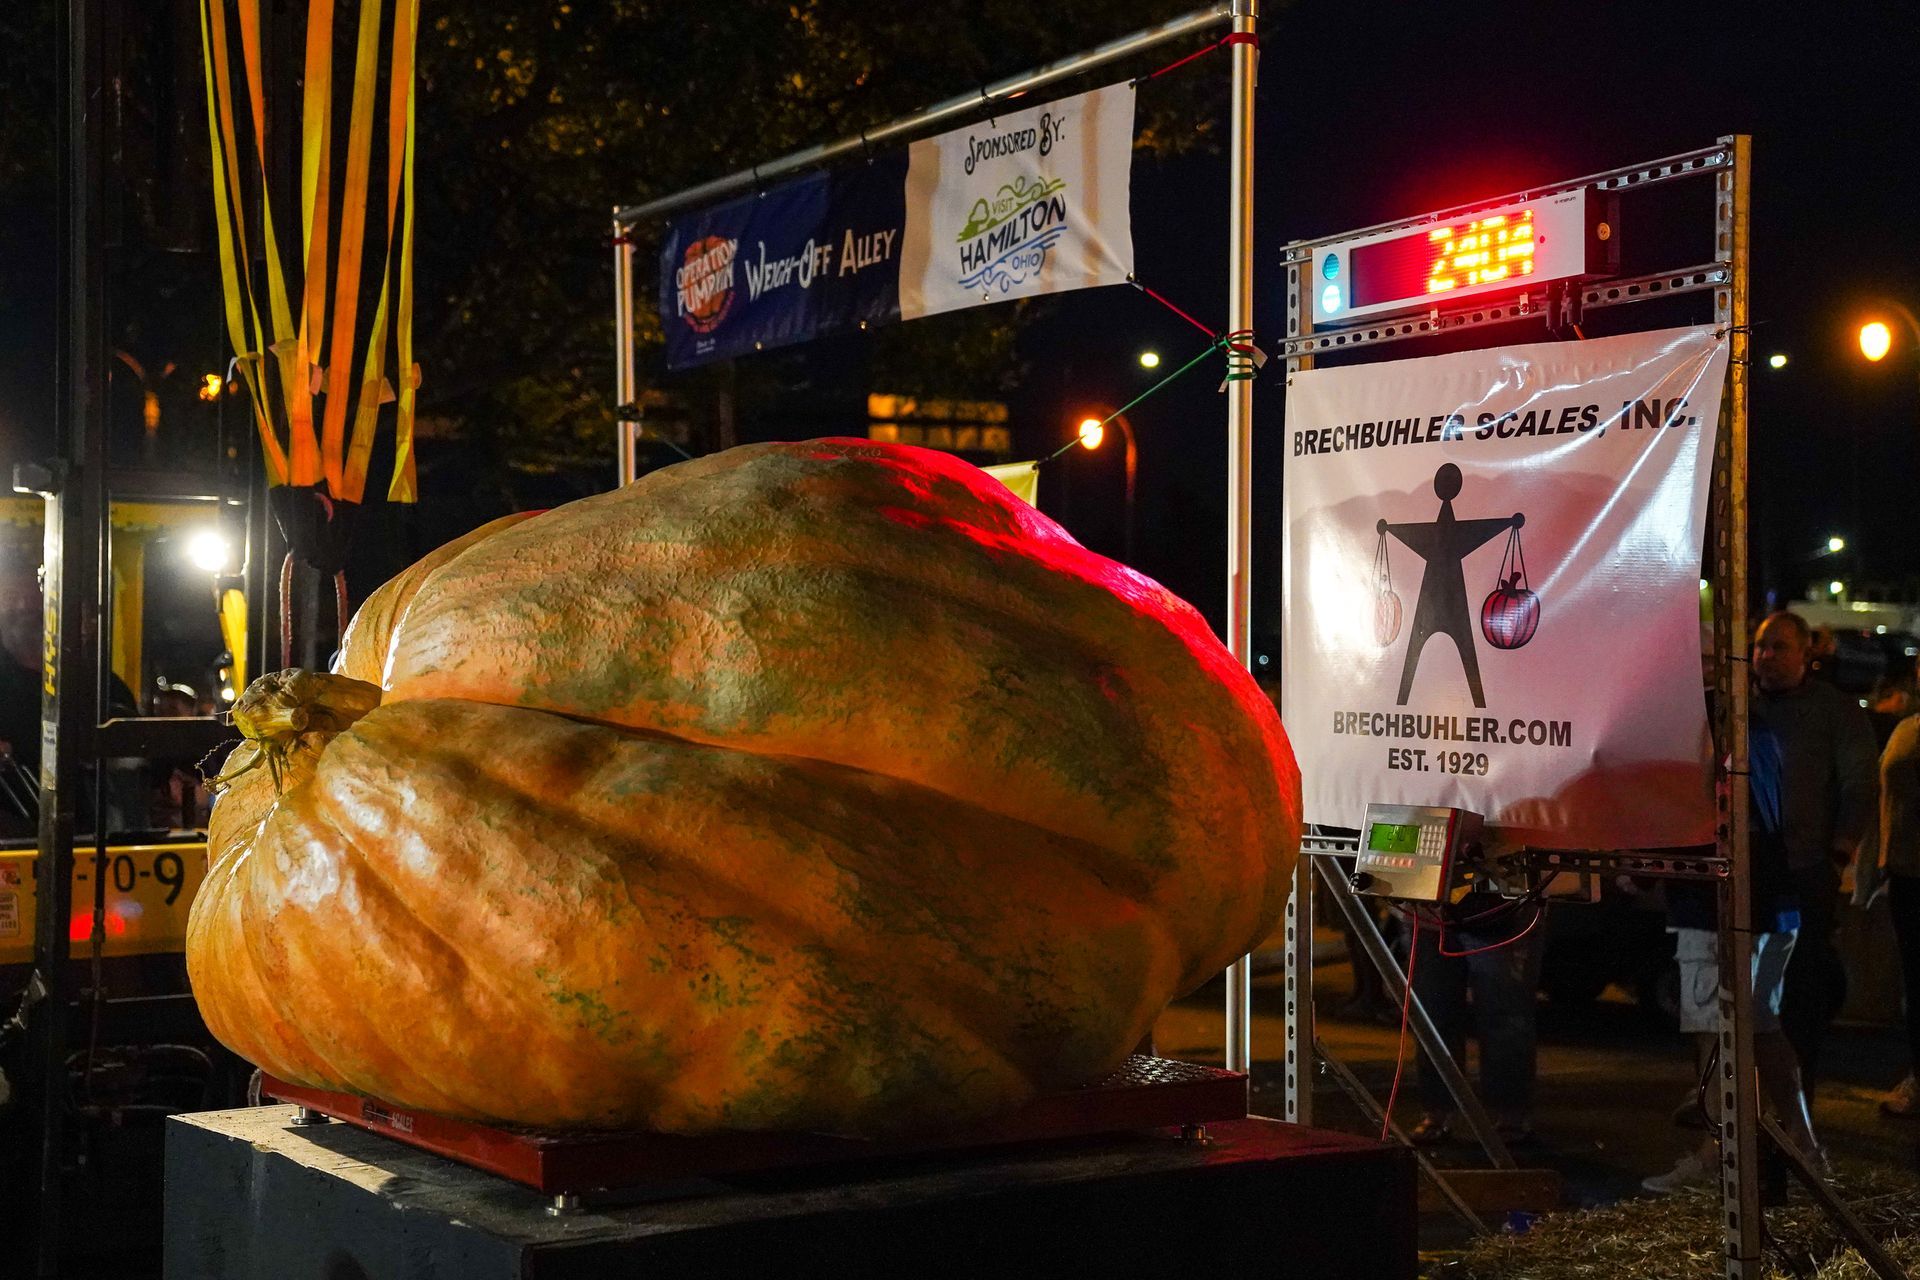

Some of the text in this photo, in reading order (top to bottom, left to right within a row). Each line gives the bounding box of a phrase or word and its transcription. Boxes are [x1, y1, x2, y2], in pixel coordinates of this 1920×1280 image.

[964, 112, 1066, 175] SPONSORED BY:
[991, 197, 1014, 215] VISIT
[960, 194, 1066, 275] HAMILTON
[676, 238, 738, 290] OPERATION
[744, 228, 897, 303] WEIGH-OFF ALLEY
[1011, 252, 1040, 270] OHIO
[1293, 397, 1697, 457] BRECHBUHLER SCALES, INC.
[1333, 711, 1573, 747] BRECHBUHLER.COM
[1388, 748, 1490, 777] EST. 1929
